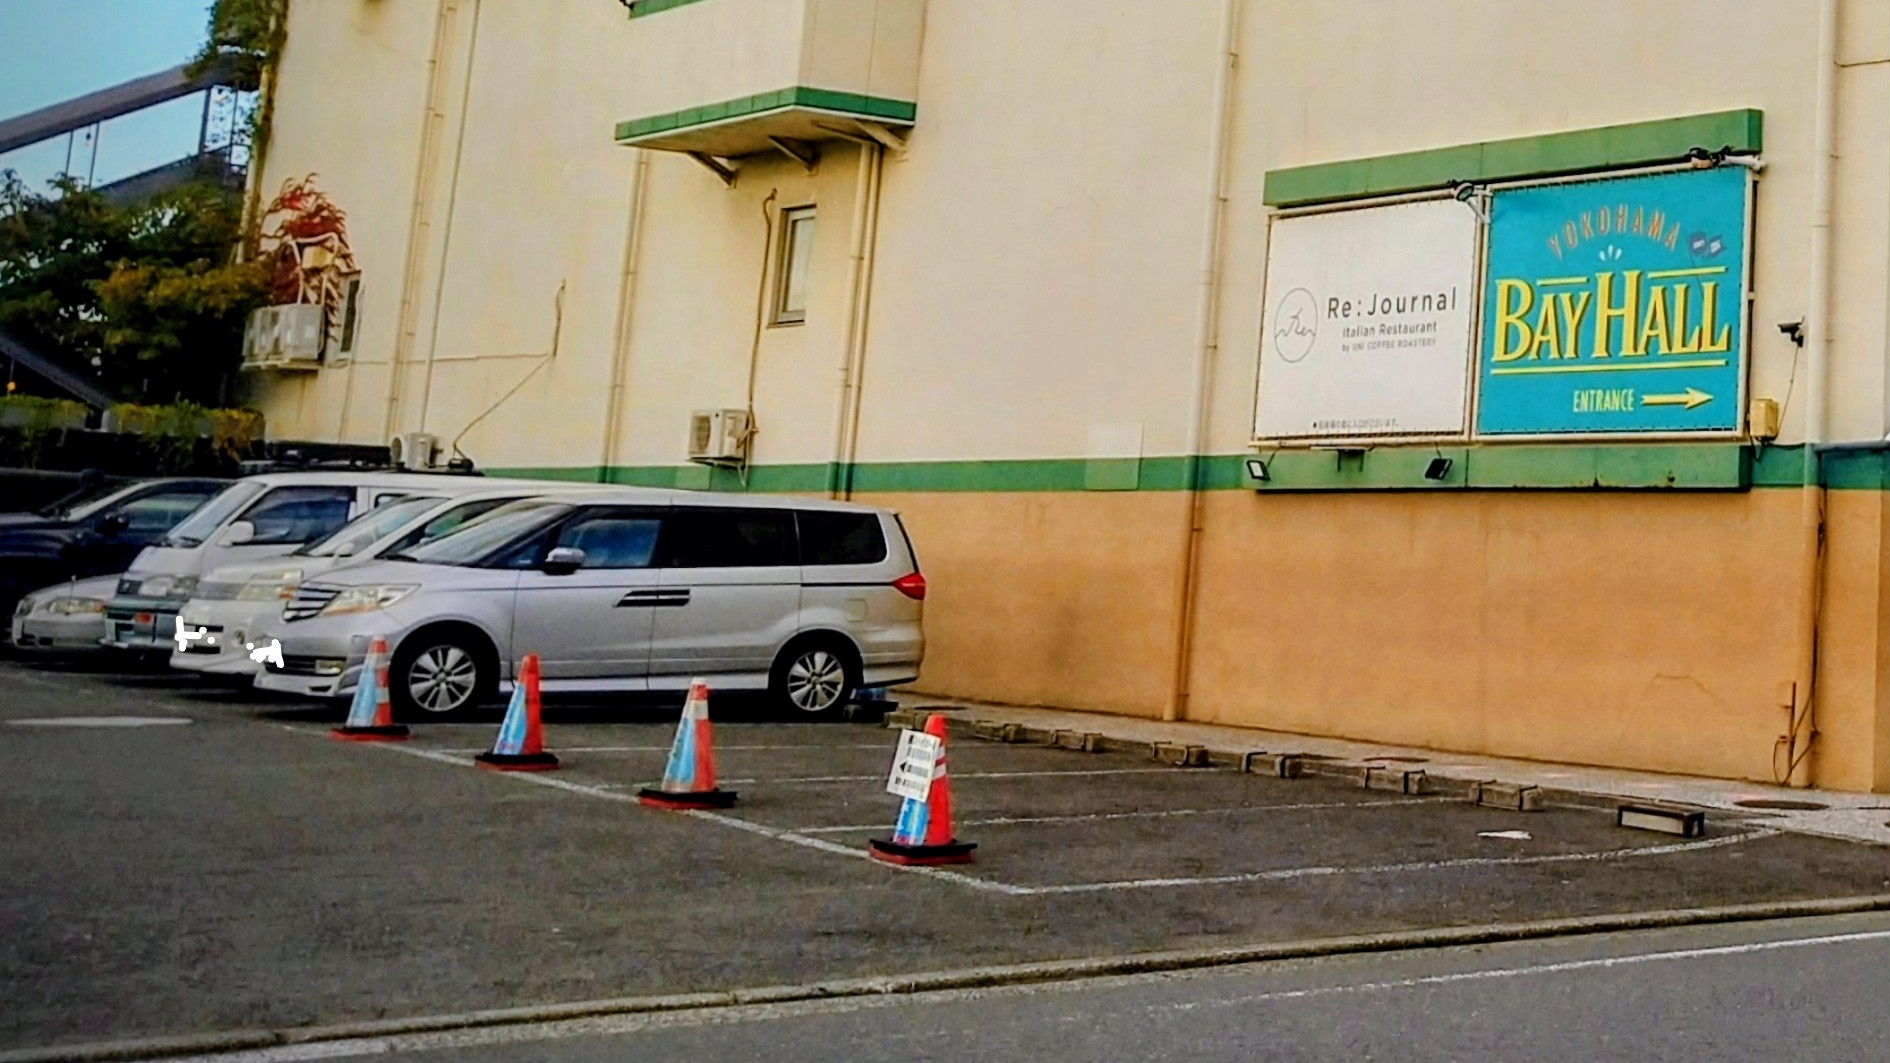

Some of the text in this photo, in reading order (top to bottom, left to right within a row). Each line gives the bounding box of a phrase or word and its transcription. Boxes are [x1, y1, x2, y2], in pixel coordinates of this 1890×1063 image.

[1547, 204, 1681, 260] YOKOHAMA
[1342, 321, 1438, 338] Italian Restaurant
[1367, 339, 1395, 350] COFFEE
[1397, 337, 1437, 348] ROASTERY
[1573, 388, 1635, 413] ENTRANCE
